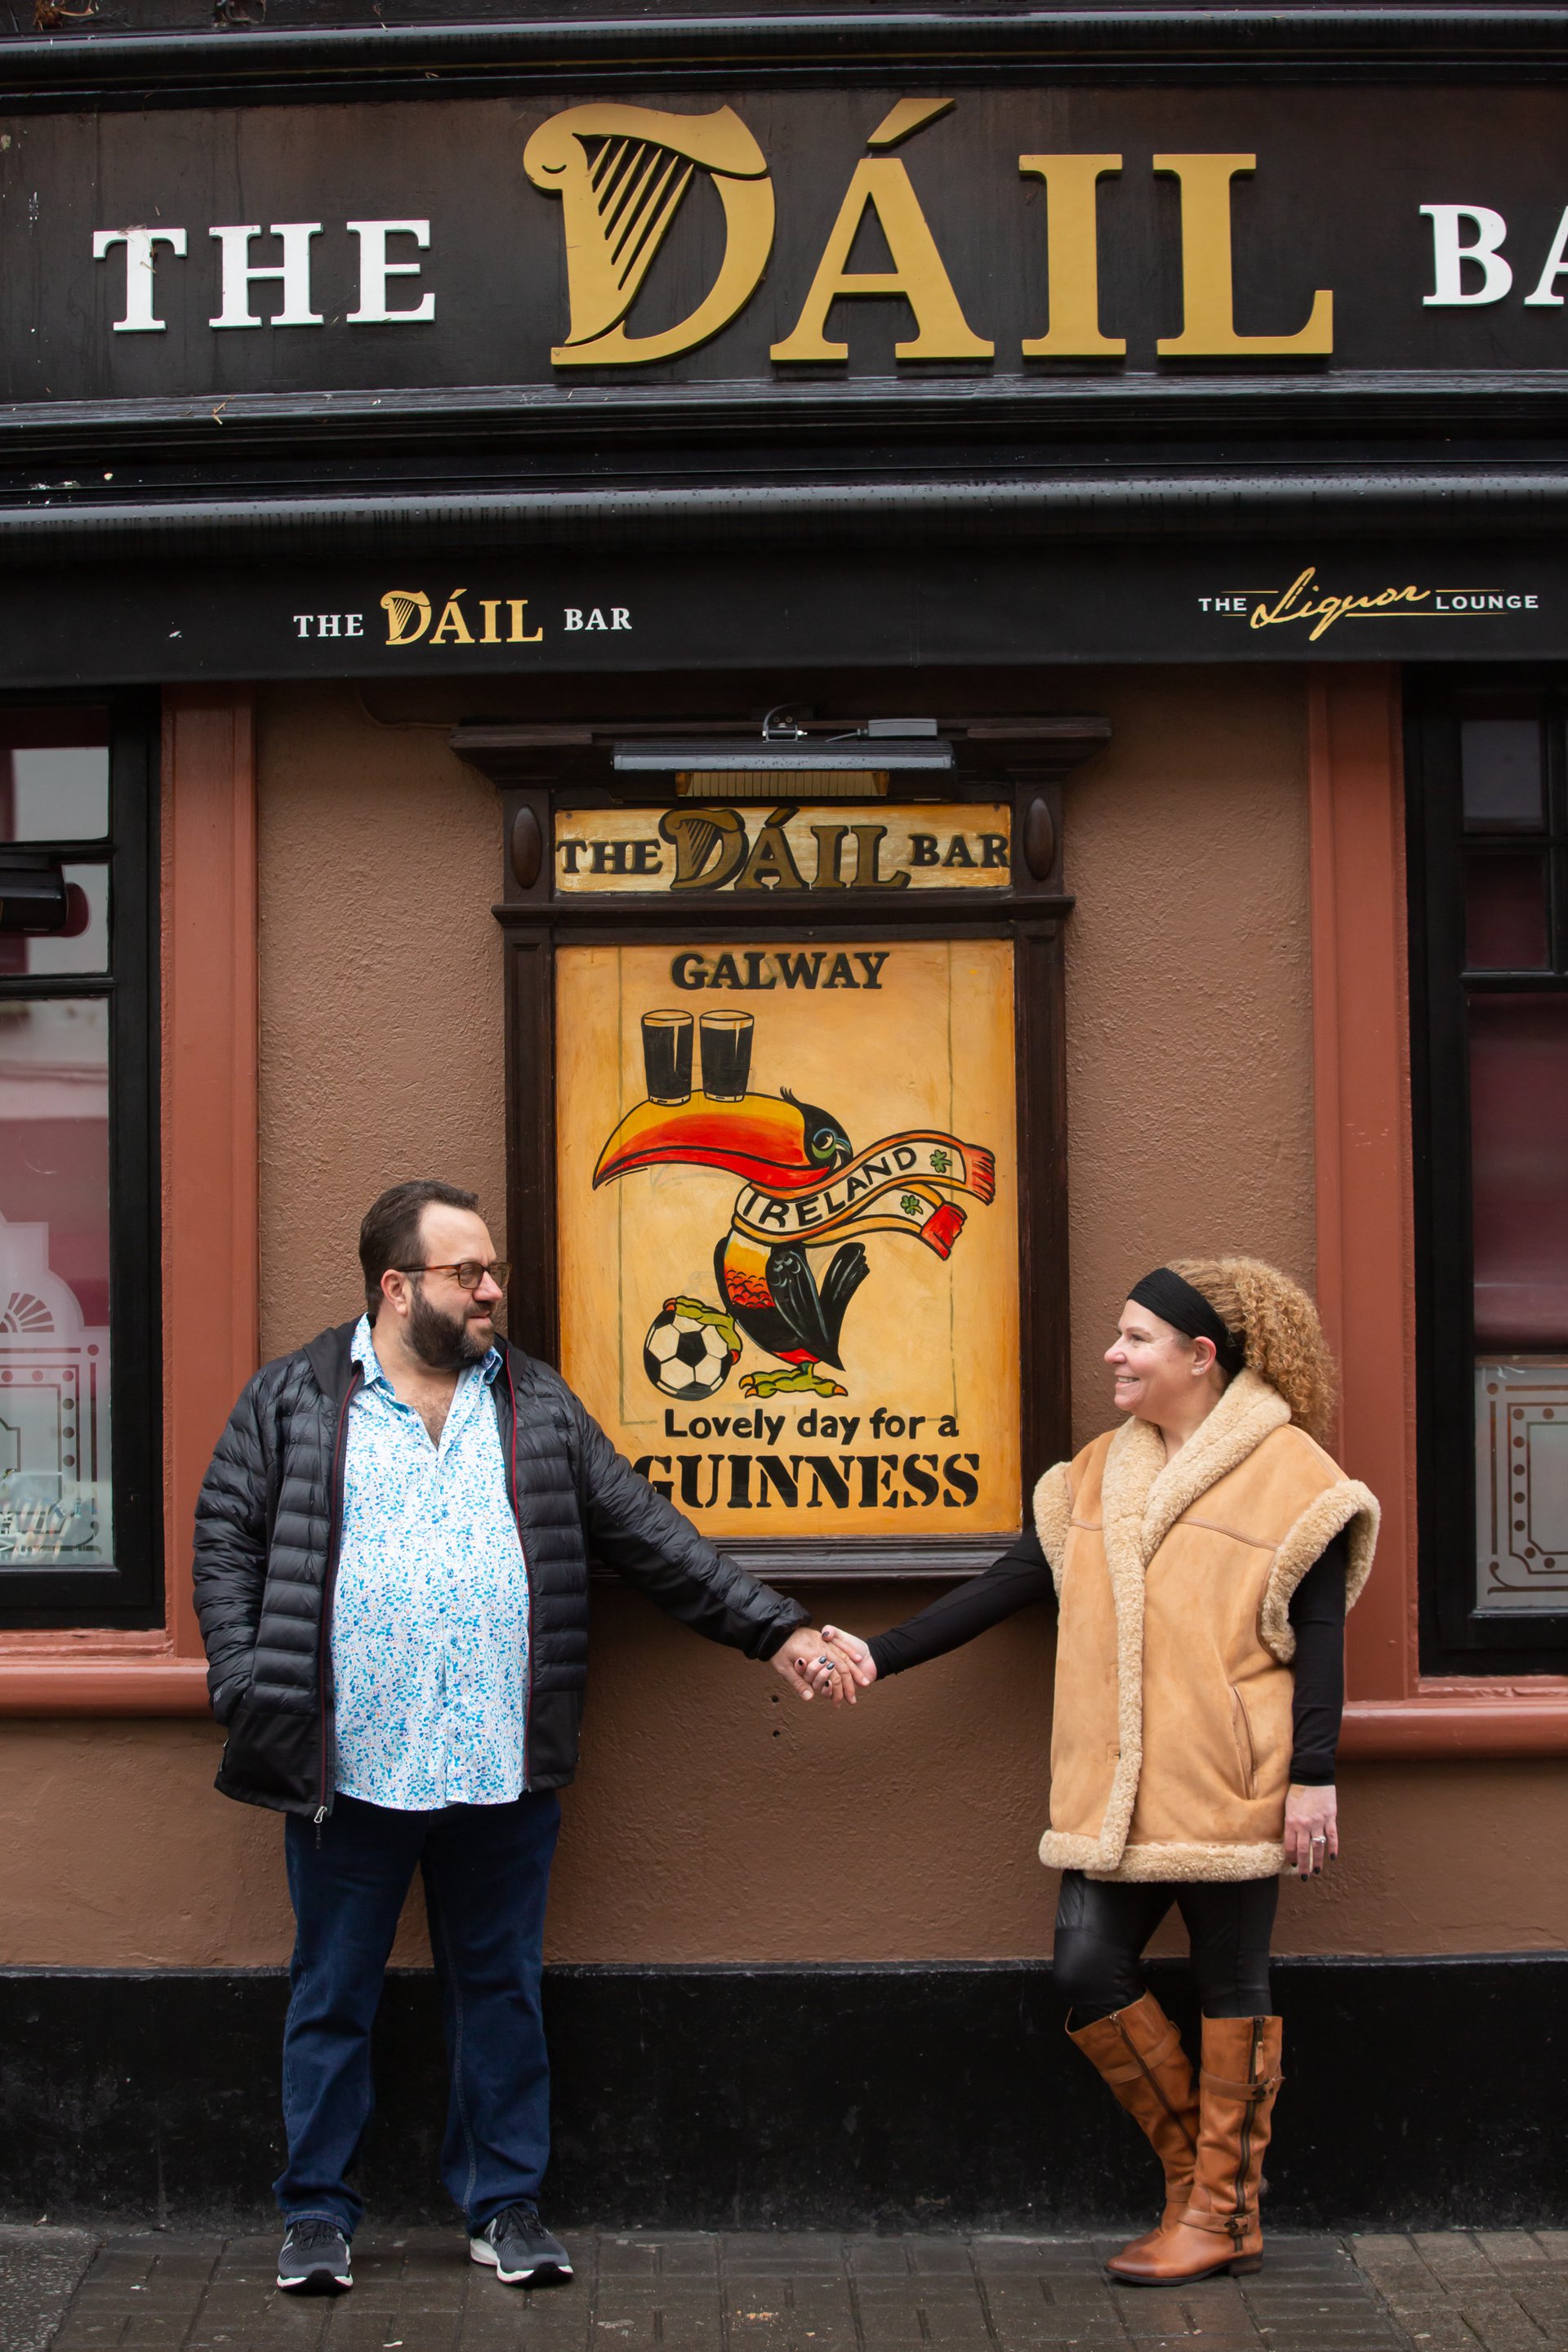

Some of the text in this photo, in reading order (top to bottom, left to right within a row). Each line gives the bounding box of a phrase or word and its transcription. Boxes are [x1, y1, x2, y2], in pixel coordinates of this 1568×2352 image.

[92, 220, 435, 332] THE
[523, 97, 1334, 365] DÁIL
[293, 588, 632, 646] THE DÁIL BAR
[1198, 567, 1539, 641] THE Liquor LOUNGE
[556, 805, 1010, 890] THE DÁIL BAR
[670, 951, 889, 990] GALWAY
[742, 1146, 917, 1228] IRELAND
[665, 1406, 960, 1446] Lovely day for a
[632, 1454, 980, 1508] GUINNESS
